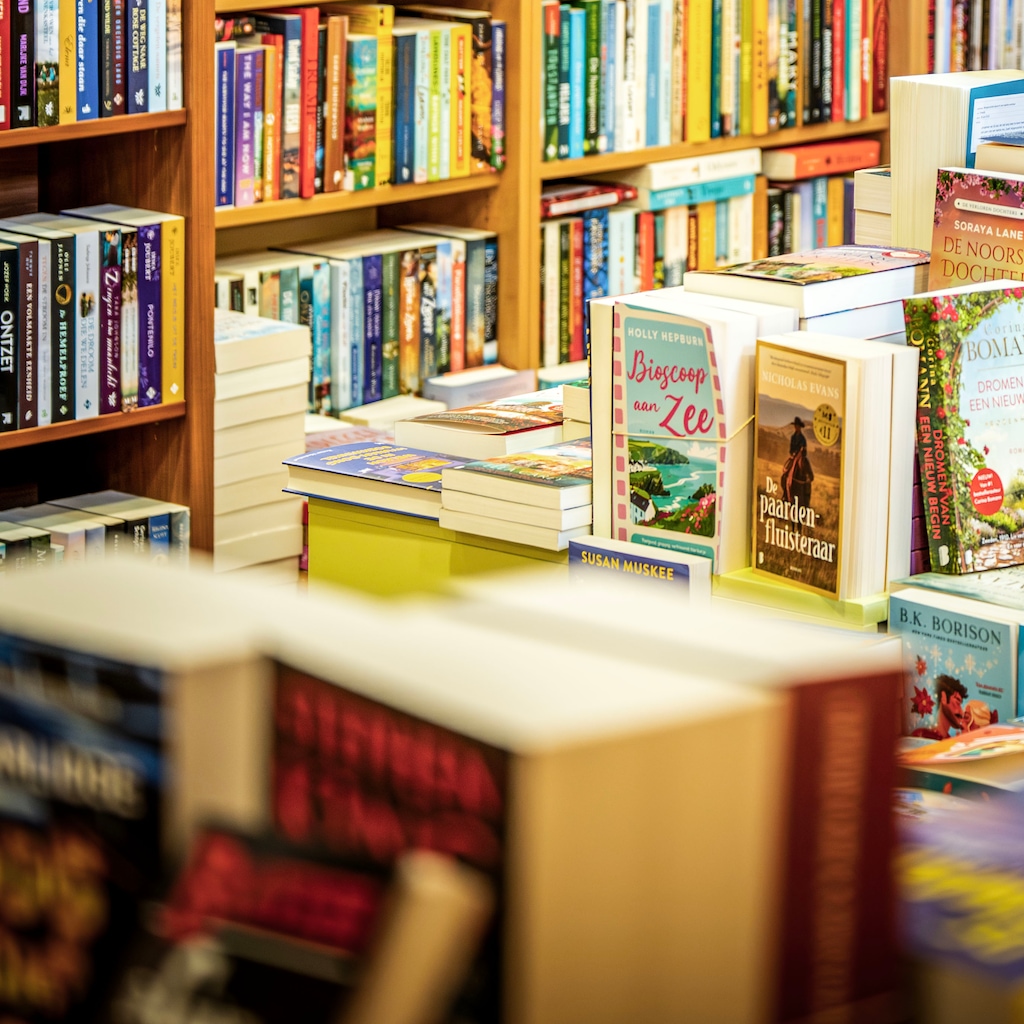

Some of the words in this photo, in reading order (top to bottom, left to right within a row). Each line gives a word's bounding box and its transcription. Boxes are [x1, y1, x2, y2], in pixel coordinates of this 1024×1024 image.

[77, 16, 86, 32] die
[77, 34, 86, 59] daar
[954, 220, 994, 238] SORAYA
[996, 227, 1024, 240] LANE
[944, 236, 962, 255] DE
[0, 310, 15, 373] ONTZET
[628, 327, 659, 341] HOLLY
[661, 331, 704, 347] HEPBURN
[627, 350, 708, 393] Bioscoop
[762, 370, 807, 392] NICHOLAS
[809, 381, 840, 400] EVANS
[977, 377, 1024, 394] DROMEN
[634, 400, 660, 413] aan
[659, 394, 714, 437] Zee
[969, 397, 990, 412] EEN
[760, 494, 821, 528] paarden-
[765, 518, 836, 563] fluisteraar
[581, 551, 620, 572] SUSAN
[622, 557, 675, 581] MUSKEE
[900, 607, 926, 628] B.K.
[932, 617, 1001, 645] BORISON
